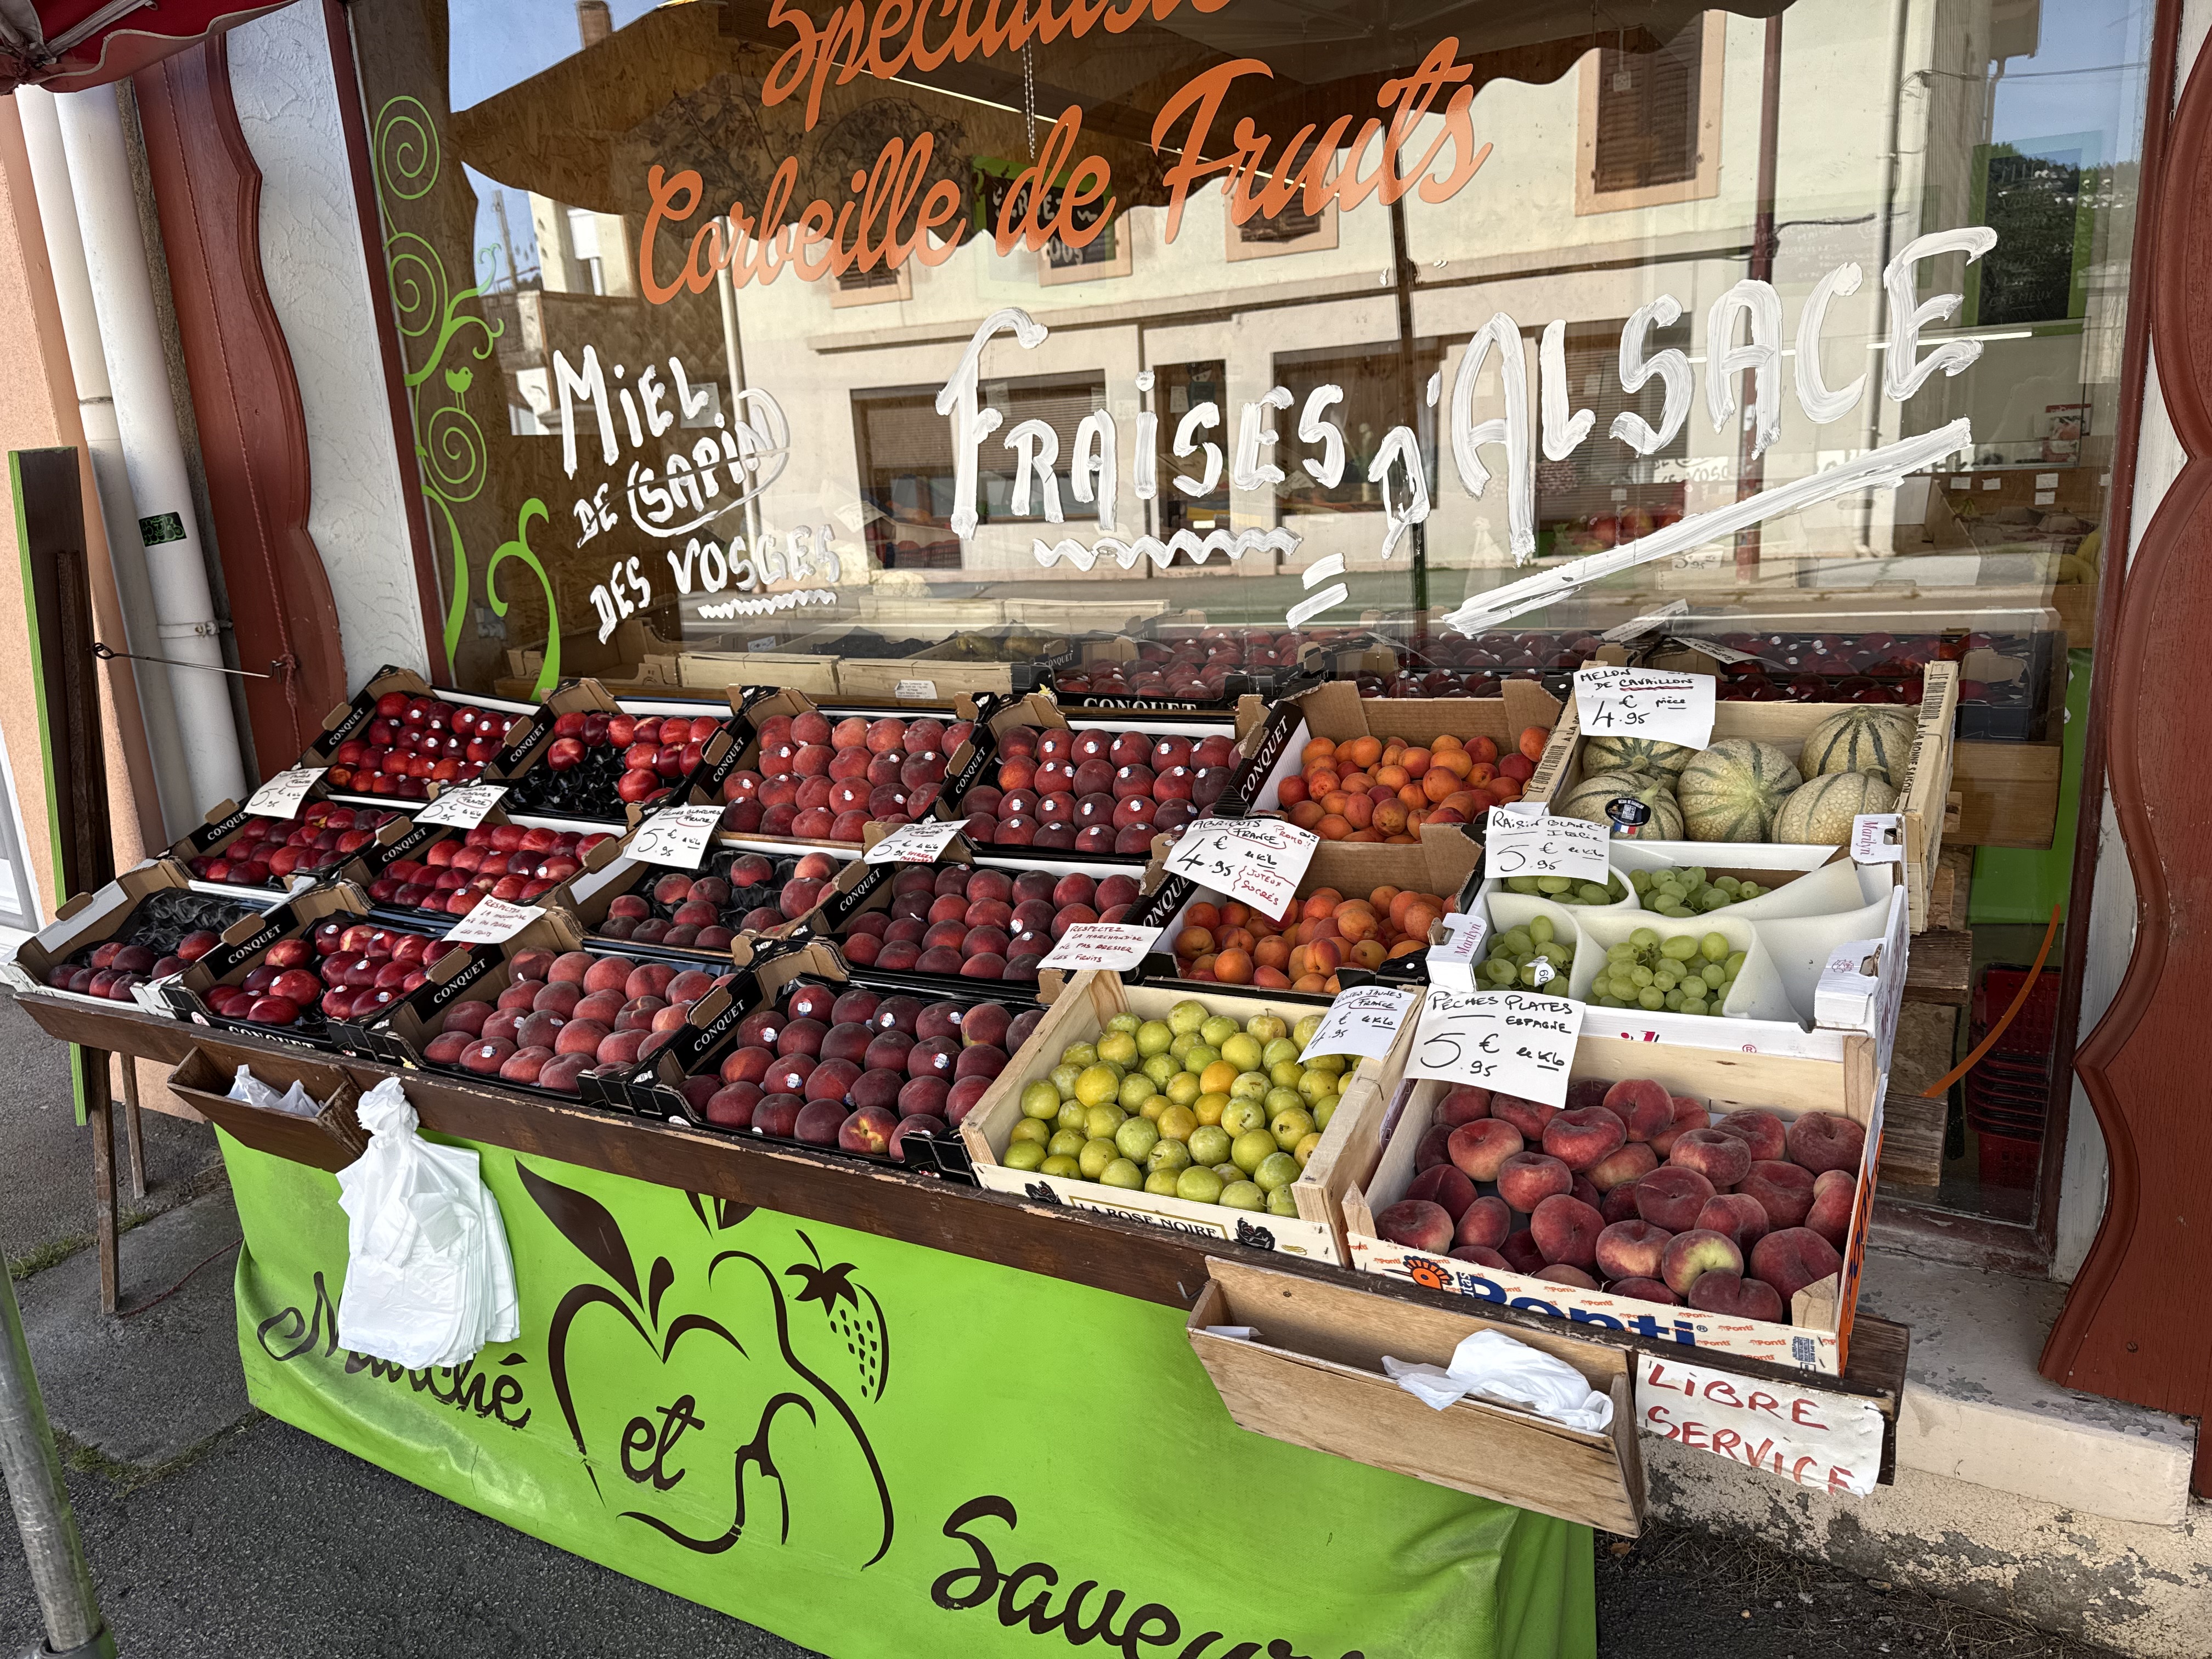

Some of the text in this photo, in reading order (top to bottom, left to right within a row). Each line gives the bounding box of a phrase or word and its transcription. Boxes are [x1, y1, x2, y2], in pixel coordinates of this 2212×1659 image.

[639, 36, 1494, 304] Corbeille de Fruits
[574, 483, 618, 549] DE
[590, 524, 843, 645] DES VOSGES
[1580, 668, 1632, 682] MELON
[1594, 681, 1613, 691] DE
[1618, 695, 1638, 708] €
[329, 707, 364, 746] CONQUET
[510, 723, 545, 763] CONQUET
[713, 737, 744, 782] CONQUET
[955, 746, 986, 794] CONQUET
[1241, 715, 1288, 801] CONQUET
[1908, 742, 1923, 765] BONNE
[1902, 767, 1916, 794] SAISON
[381, 827, 427, 862] CONQUET
[1213, 836, 1228, 850] €
[1233, 828, 1279, 845] FRANCE
[1539, 843, 1559, 854] €
[1855, 820, 1879, 856] Marilyn
[839, 868, 882, 912] CONQUET
[228, 924, 281, 964] CONQUET
[1453, 922, 1482, 958] Marilyn
[433, 958, 487, 1004] CONQUET
[1365, 989, 1402, 998] JAUNES
[1358, 998, 1395, 1008] FRANCE
[1505, 995, 1573, 1014] PLATES
[693, 999, 746, 1052] CONQUET
[1505, 1016, 1572, 1034] ESPAGNE
[1479, 1033, 1500, 1053] €
[1159, 1218, 1220, 1239] NOIRE
[620, 1394, 706, 1492] et
